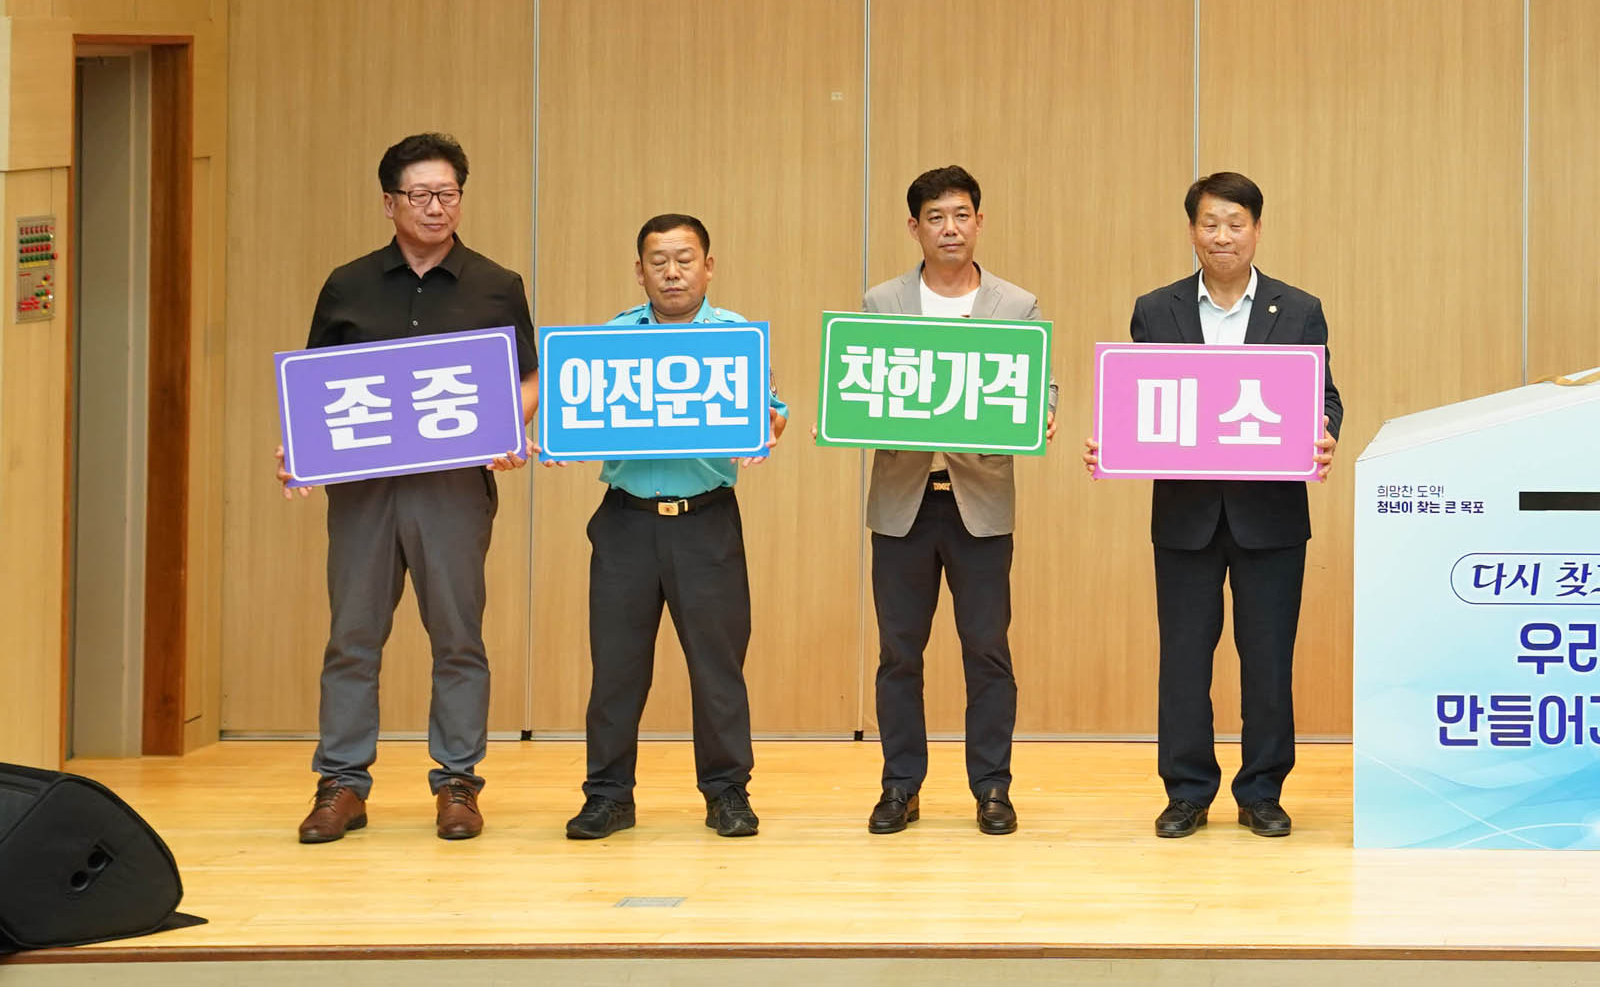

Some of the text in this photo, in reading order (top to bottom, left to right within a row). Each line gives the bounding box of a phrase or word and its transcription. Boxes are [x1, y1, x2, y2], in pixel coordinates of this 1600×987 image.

[559, 355, 749, 430] 안전운전
[837, 345, 1030, 424] 착한가격
[1377, 485, 1444, 498] 희망찬 도약!
[1377, 501, 1484, 514] 청년이 찾는 큰 목포
[1472, 562, 1541, 596] 다시
